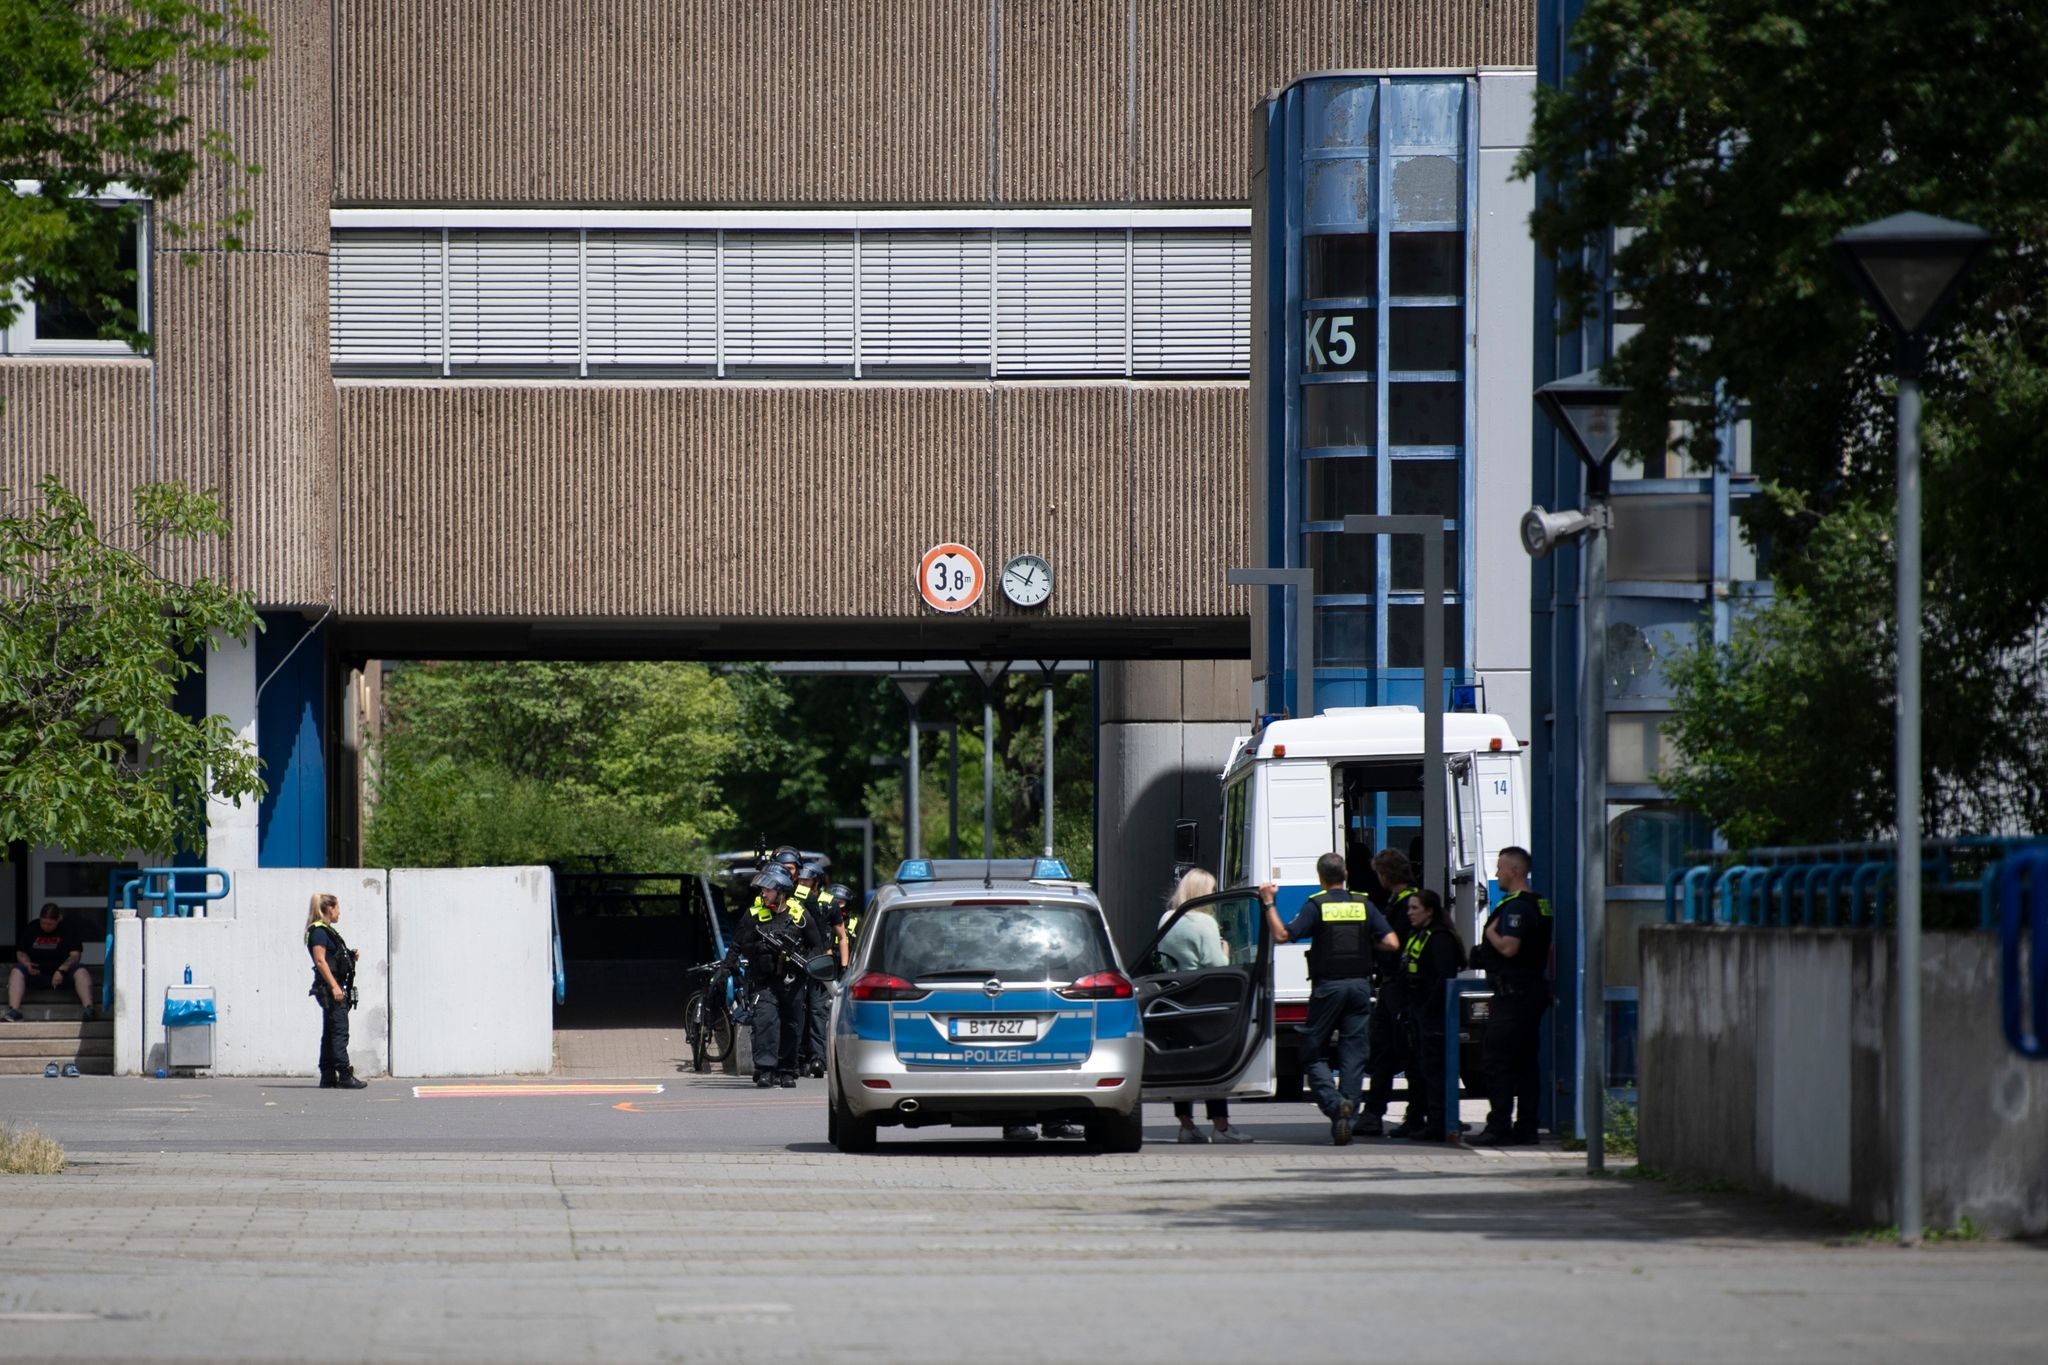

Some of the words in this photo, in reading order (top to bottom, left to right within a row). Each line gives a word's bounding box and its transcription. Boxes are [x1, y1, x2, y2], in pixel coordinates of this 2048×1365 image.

[1305, 316, 1356, 366] K5
[1494, 780, 1507, 795] 14
[988, 1020, 1024, 1034] 7627
[964, 1050, 1021, 1062] POLIZEI
